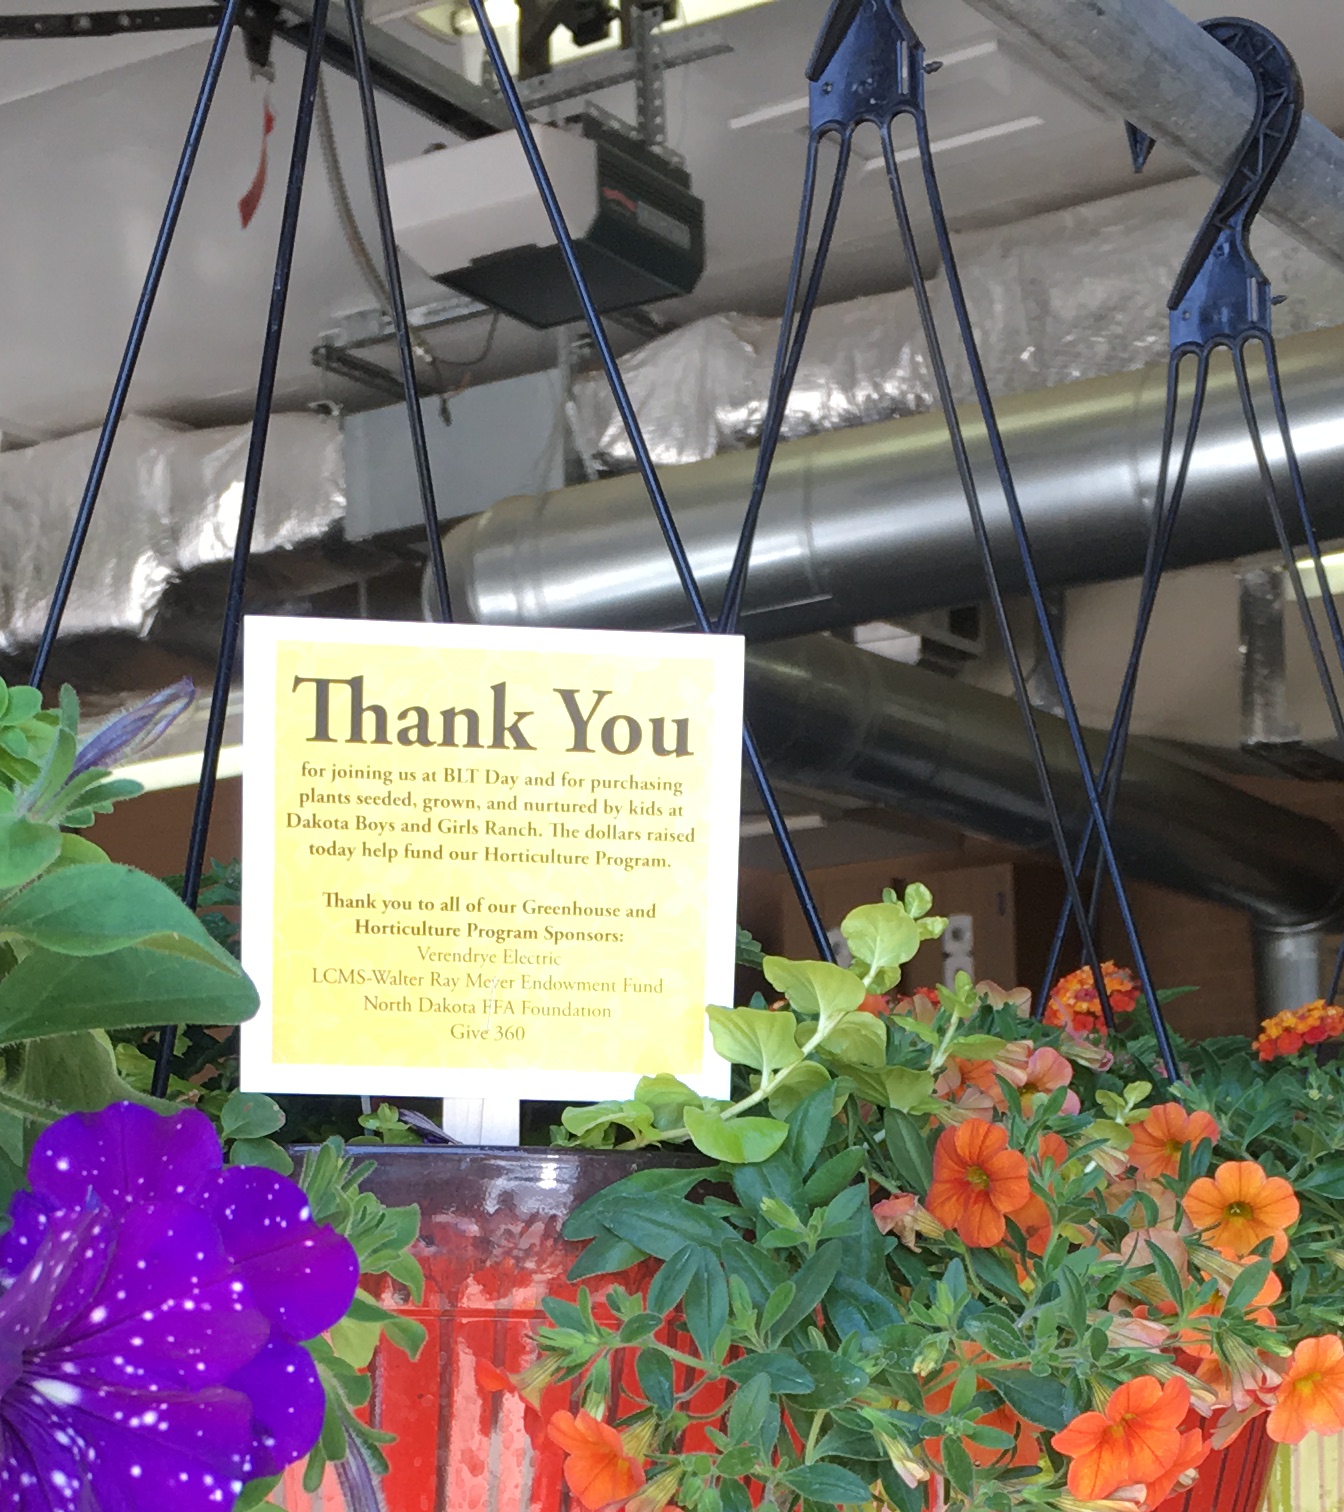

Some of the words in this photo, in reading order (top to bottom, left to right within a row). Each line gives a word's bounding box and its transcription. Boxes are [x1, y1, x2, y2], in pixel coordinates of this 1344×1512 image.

[291, 673, 537, 751] Thank
[552, 688, 694, 758] You
[301, 761, 326, 778] for
[331, 763, 393, 786] joining
[399, 769, 416, 782] us
[422, 770, 436, 783] at
[443, 767, 479, 783] BLT
[485, 769, 518, 790] Day
[524, 771, 555, 787] and
[561, 771, 585, 787] for
[591, 774, 683, 796] purchasing
[299, 787, 351, 808] plants
[356, 790, 417, 809] seeded,
[422, 797, 481, 812] grown,
[487, 795, 517, 811] and
[524, 798, 597, 814] nurtured
[603, 798, 623, 819] by
[629, 799, 663, 816] kids
[668, 803, 683, 817] at
[286, 812, 349, 830] Dakota
[356, 815, 395, 836] Boys
[400, 817, 432, 833] and
[437, 818, 479, 835] Girls
[485, 820, 542, 837] Ranch.
[549, 822, 579, 839] The
[585, 823, 641, 841] dollars
[647, 827, 695, 843] raised
[309, 840, 355, 861] today
[361, 841, 398, 863] help
[404, 843, 443, 860] fund
[449, 850, 479, 861] our
[485, 847, 590, 865] Horticulture
[595, 850, 671, 870] Program.
[322, 891, 377, 909] Thank
[381, 899, 412, 914] you
[418, 899, 435, 911] to
[440, 896, 460, 912] all
[465, 896, 485, 913] of
[488, 903, 517, 914] our
[522, 899, 620, 917] Greenhouse
[625, 903, 656, 918] and
[355, 918, 461, 937] Horticulture
[466, 922, 538, 944] Program
[543, 925, 624, 945] Sponsors:
[417, 945, 497, 968] Verendrye
[503, 948, 562, 966] Electric
[312, 967, 424, 987] LCMS-Walter
[430, 971, 460, 992] Ray
[465, 973, 515, 992] Meyer
[521, 974, 616, 992] Endowment
[623, 977, 663, 993] Fund
[363, 995, 412, 1012] North
[418, 997, 476, 1014] Dakota
[483, 999, 515, 1015] FFA
[522, 1000, 611, 1018] Foundation
[450, 1022, 489, 1041] Give
[494, 1025, 526, 1041] 360
